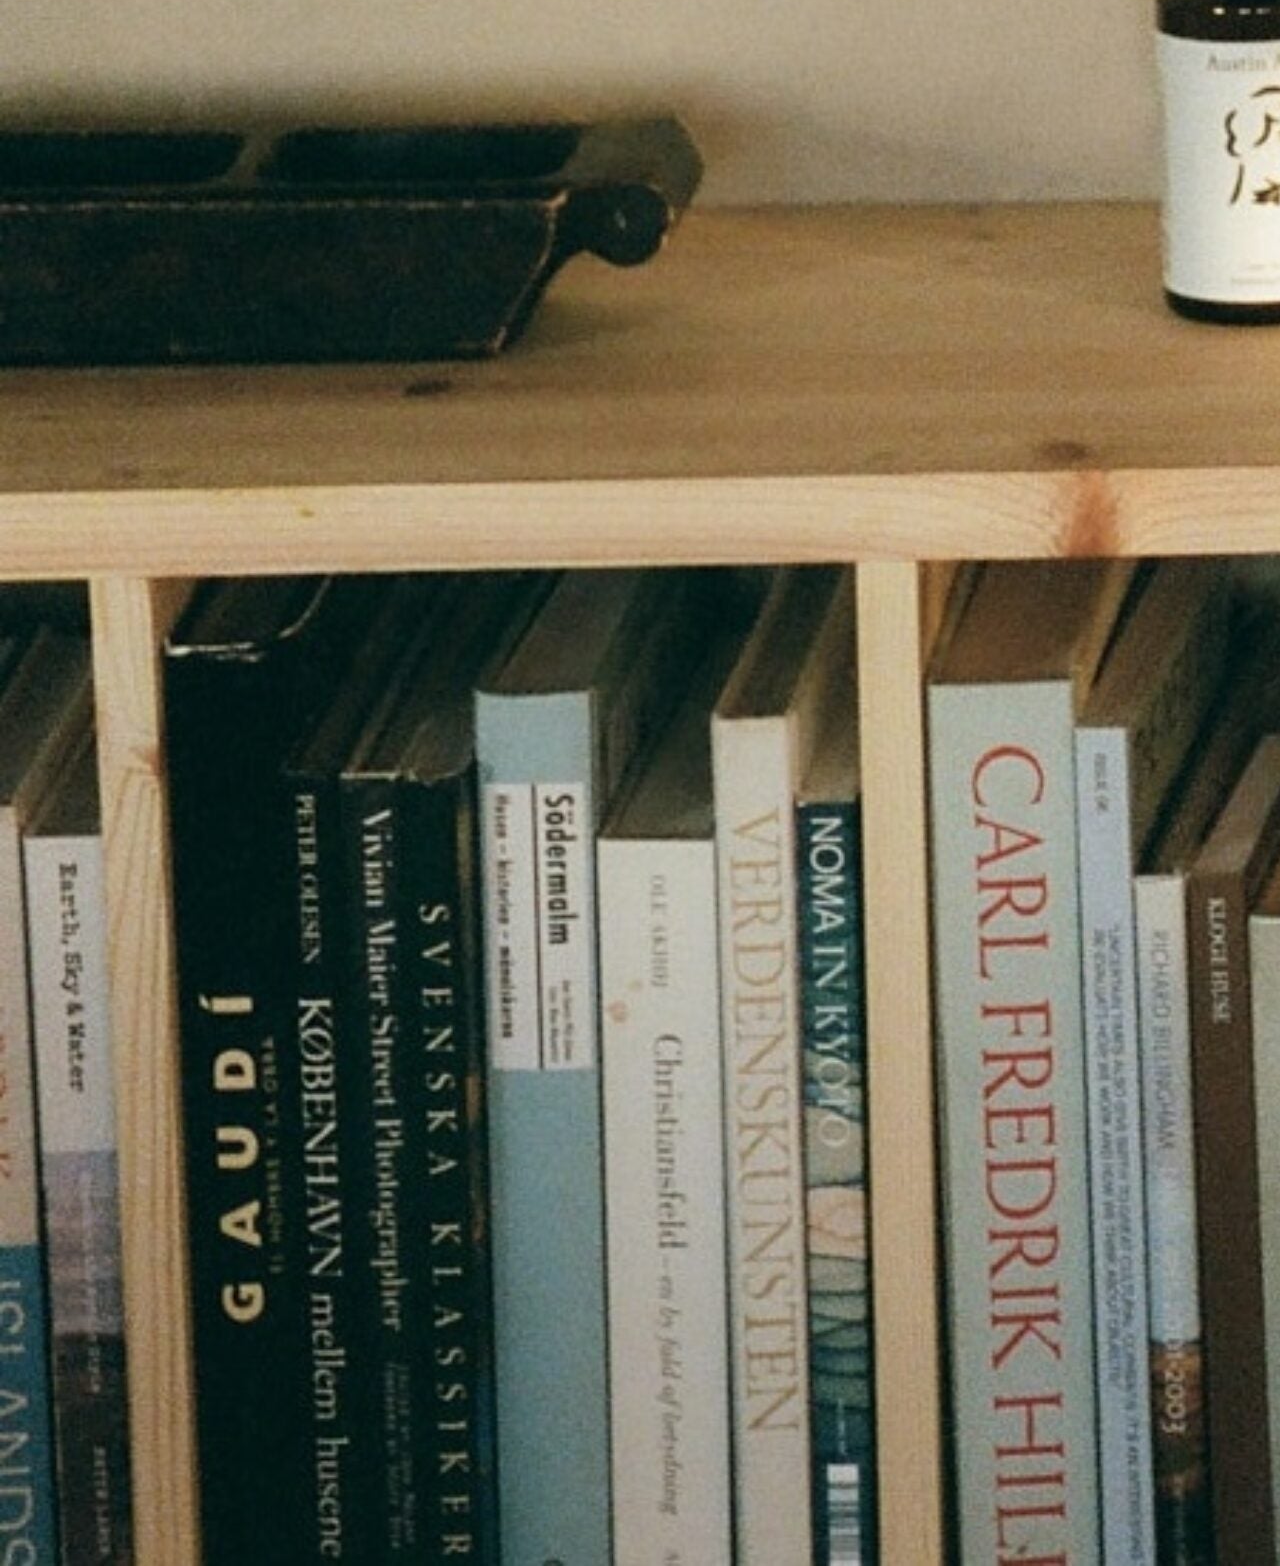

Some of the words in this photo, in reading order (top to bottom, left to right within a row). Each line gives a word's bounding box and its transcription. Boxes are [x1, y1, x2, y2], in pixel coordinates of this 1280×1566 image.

[1206, 54, 1267, 72] Austin
[294, 792, 316, 866] PETER
[360, 809, 393, 907] Vivian
[544, 793, 579, 945] Södermalm
[809, 816, 845, 933] NOMA
[971, 743, 1047, 979] CARL
[298, 872, 322, 964] OLESEN
[650, 874, 668, 915] OLE
[62, 951, 82, 994] Sky
[365, 920, 396, 1002] Maier
[812, 944, 846, 990] IN
[66, 1025, 88, 1094] Water
[368, 1014, 401, 1107] Street
[418, 903, 457, 1175] SVENSKA
[812, 1004, 852, 1149] KYOTO
[198, 994, 265, 1323] GAUDÍ
[296, 996, 345, 1278] KØBENHAVN
[651, 1033, 688, 1250] Christiansfeld
[728, 808, 801, 1435] VERDENSKUNSTEN
[365, 1118, 406, 1332] Photographer
[980, 999, 1064, 1370] FREDRIK
[657, 1305, 683, 1330] by
[658, 1274, 677, 1300] en
[308, 1292, 346, 1421] mellem
[431, 1223, 474, 1556] KLASSIKER
[656, 1335, 683, 1379] fuld
[312, 1436, 350, 1559] husene
